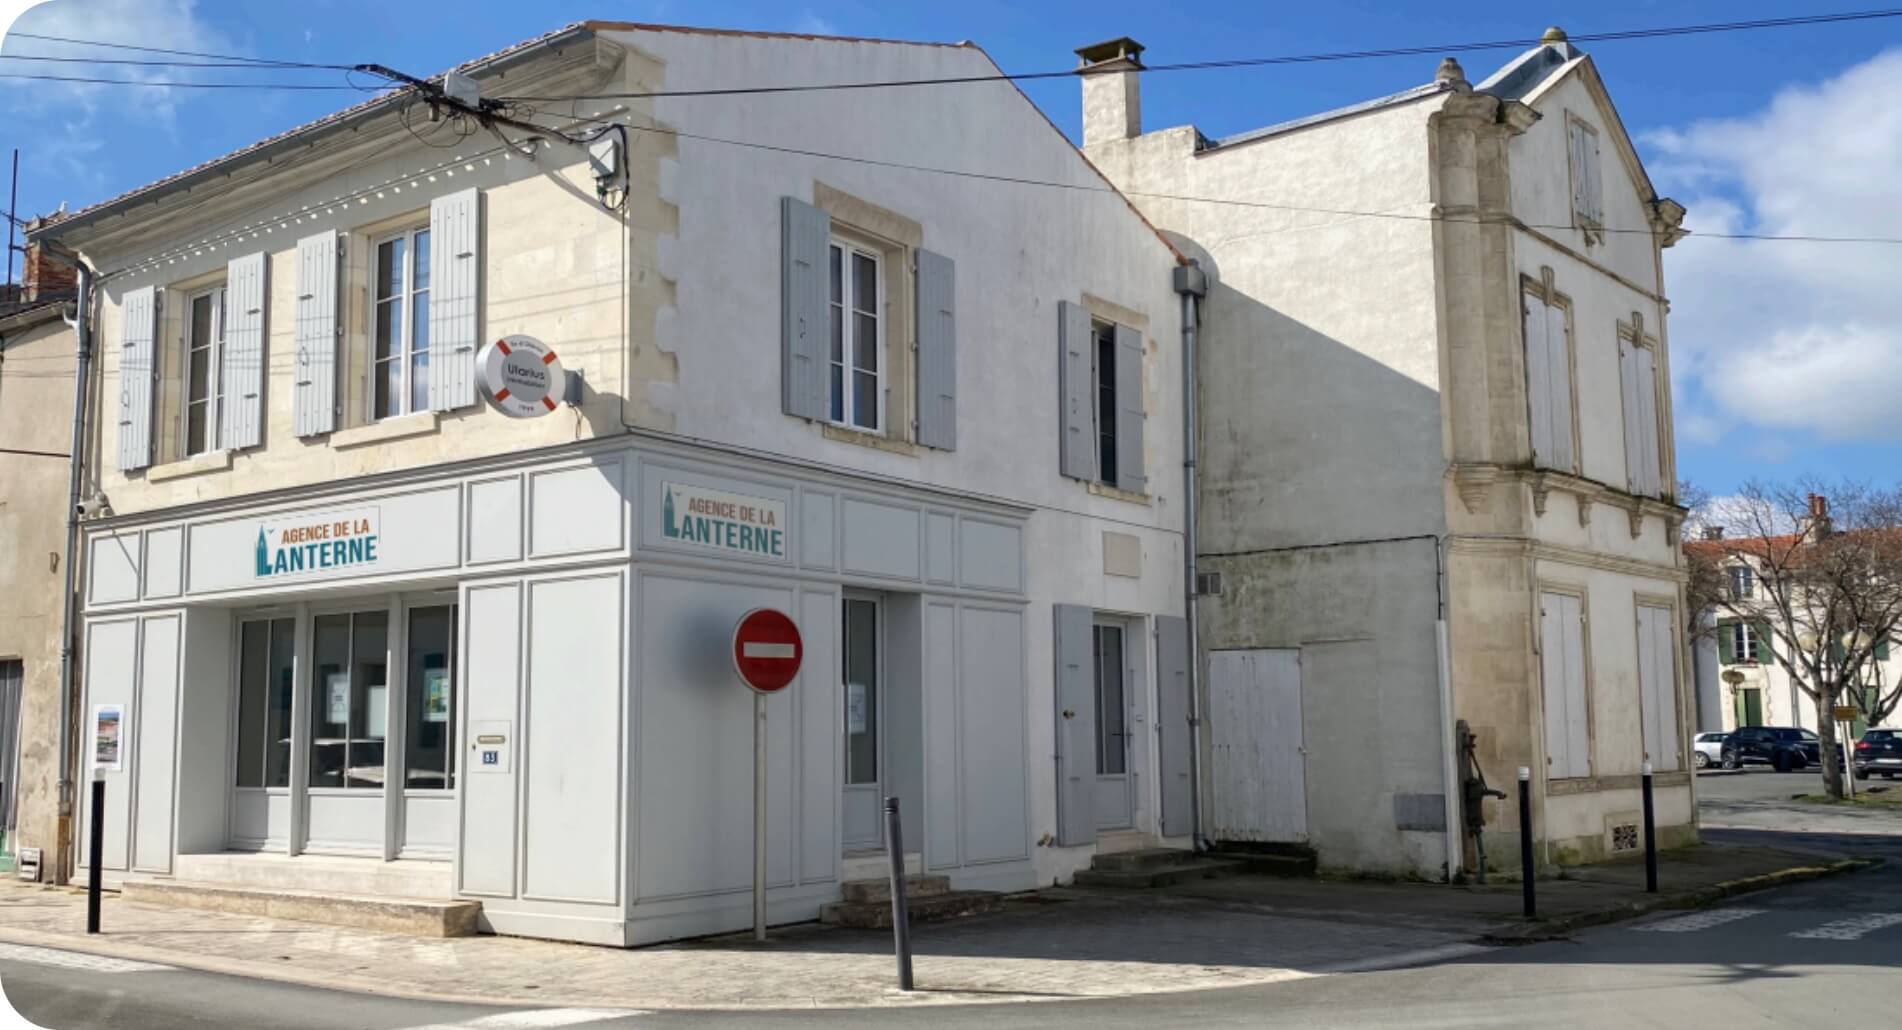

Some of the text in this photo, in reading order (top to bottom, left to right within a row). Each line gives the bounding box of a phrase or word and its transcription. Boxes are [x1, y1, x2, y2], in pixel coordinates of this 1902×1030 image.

[688, 497, 776, 526] AGENCE DE LA
[281, 518, 370, 544] AGENCE DE LA
